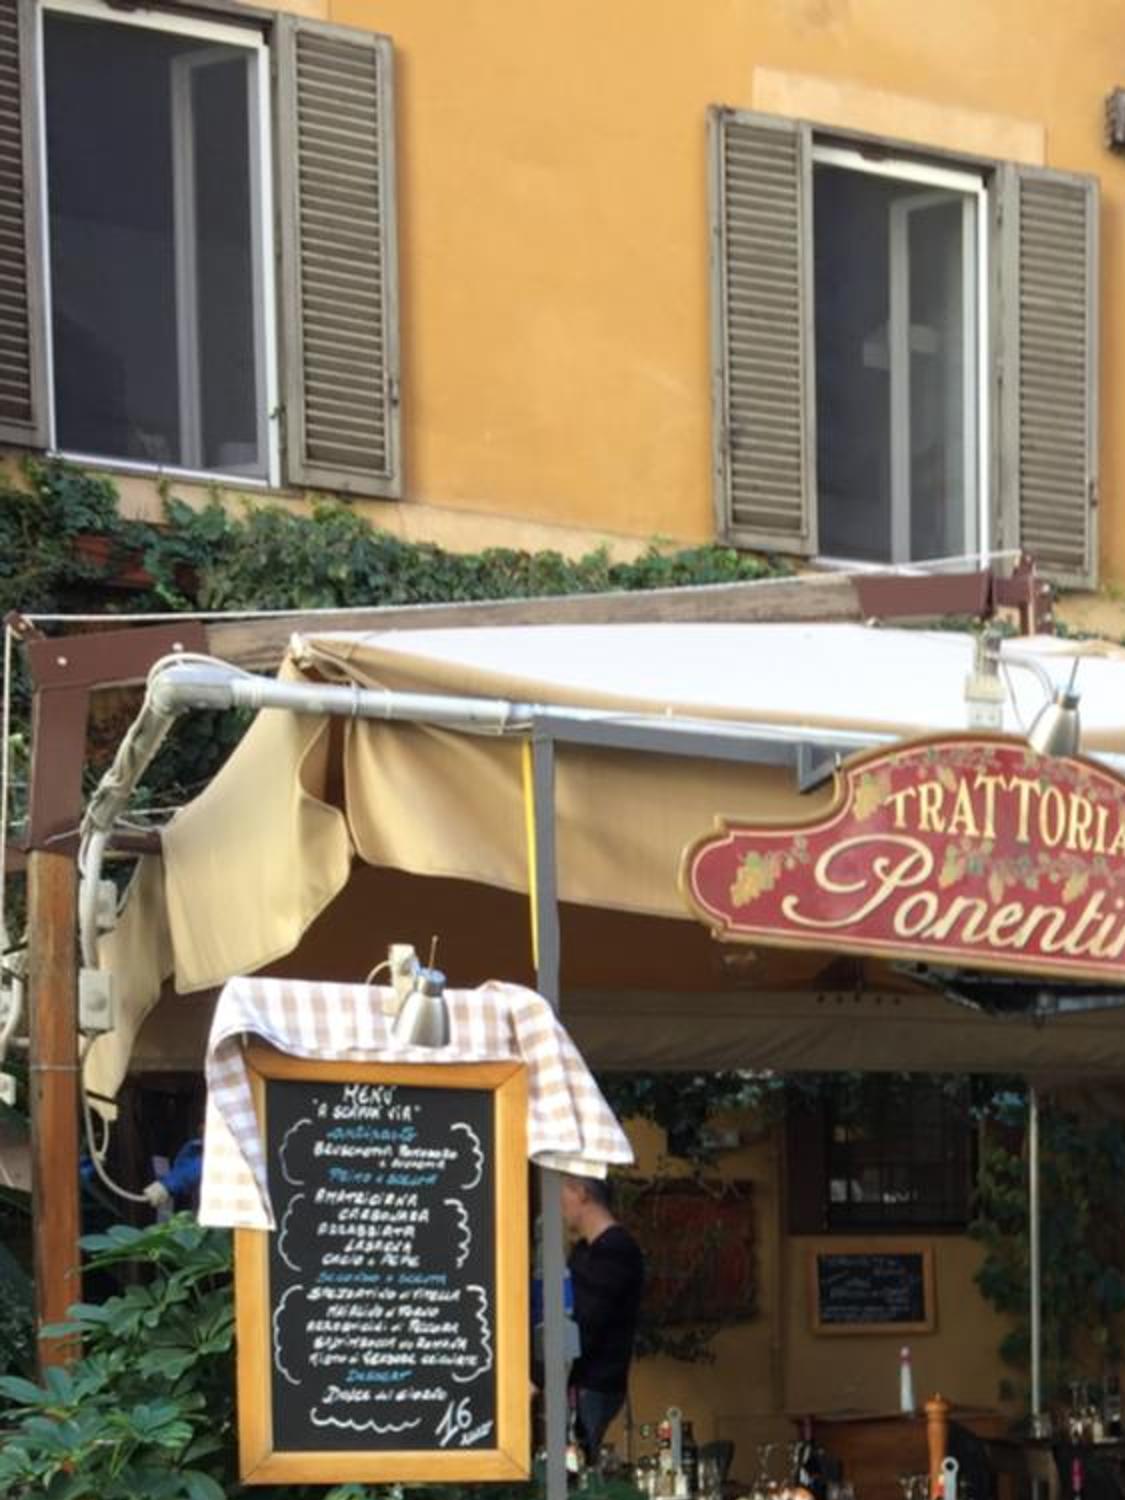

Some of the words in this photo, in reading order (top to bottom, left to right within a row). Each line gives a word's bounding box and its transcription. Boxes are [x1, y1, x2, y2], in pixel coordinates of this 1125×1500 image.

[313, 1187, 419, 1207] AMATRICIANA
[337, 1207, 430, 1223] CARBONARA
[316, 1221, 416, 1239] ARRABBIATA
